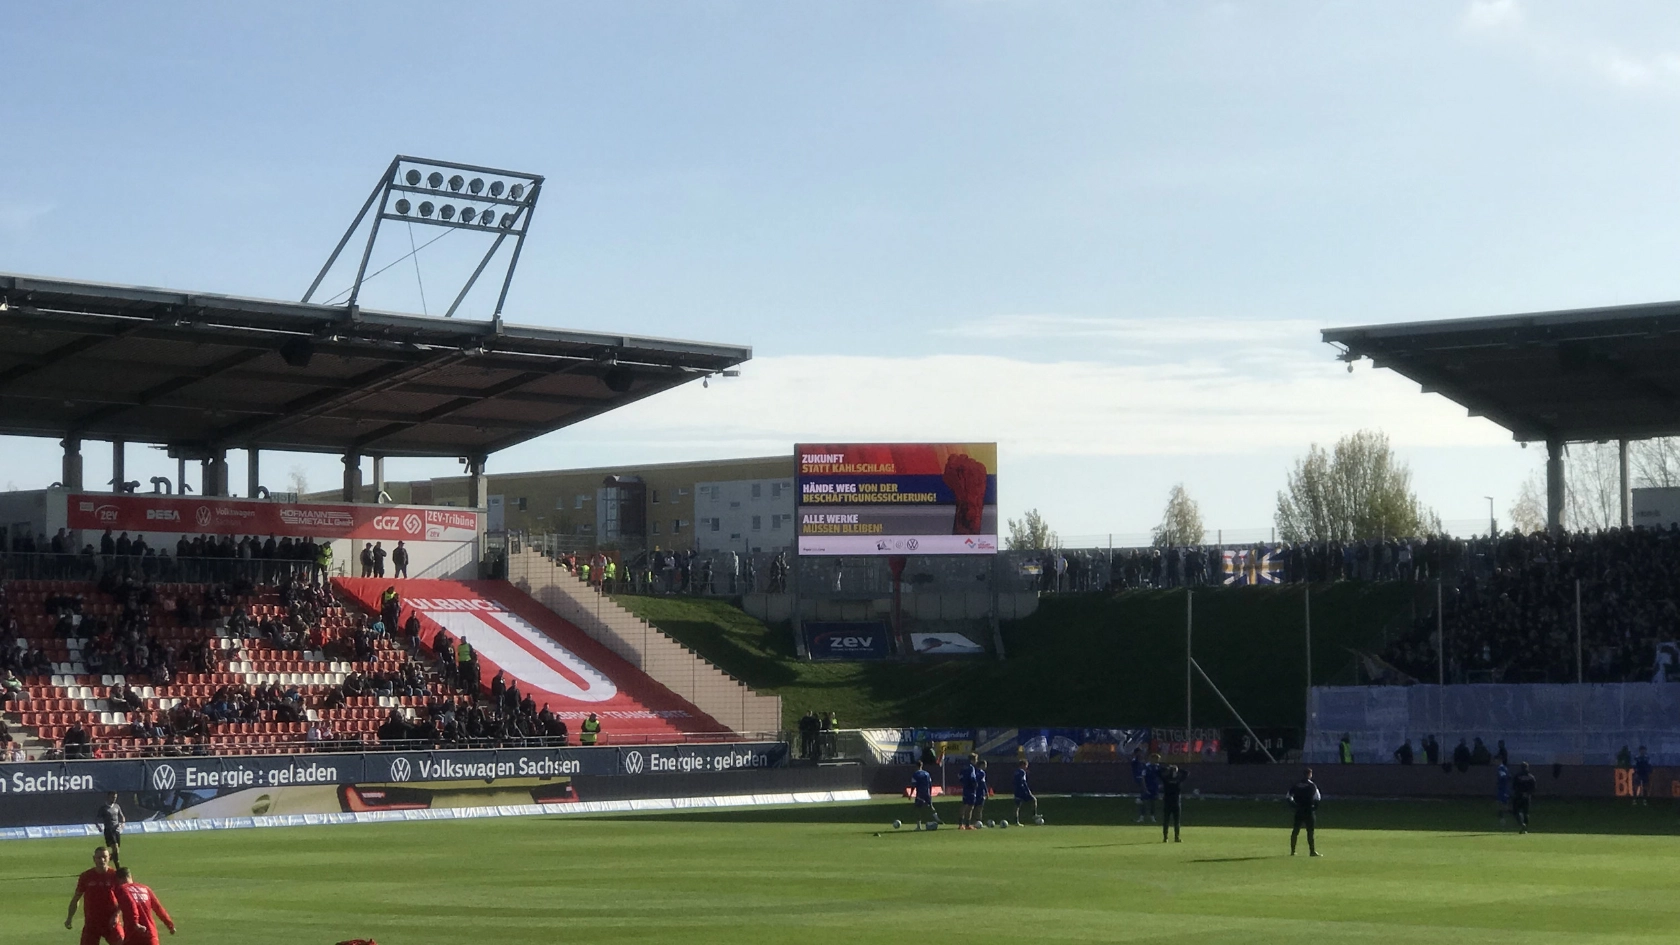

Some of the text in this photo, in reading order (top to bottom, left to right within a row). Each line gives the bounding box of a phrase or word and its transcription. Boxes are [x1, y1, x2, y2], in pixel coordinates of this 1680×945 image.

[802, 454, 844, 463] ZUKUNFT
[802, 463, 895, 473] STATT KAHLSCHLAG!
[803, 482, 898, 493] HÄNDE WEG VON DER
[803, 493, 937, 502] BESCHÄFTIGUNGSSICHERUNG!
[280, 509, 328, 518] HOFMANN
[427, 510, 475, 528] ZEV-Tribüne
[803, 514, 858, 524] ALLE WERKE
[298, 517, 334, 526] METALL
[373, 515, 400, 531] GGZ
[803, 523, 883, 533] MÜSSEN BLEIBEN!
[829, 636, 873, 648] zev
[650, 752, 703, 772] Energie
[714, 750, 768, 770] geladen
[419, 756, 580, 779] Volkswagen Sachsen
[186, 765, 254, 788] Energie
[268, 762, 337, 786] geladen
[12, 770, 94, 792] Sachsen
